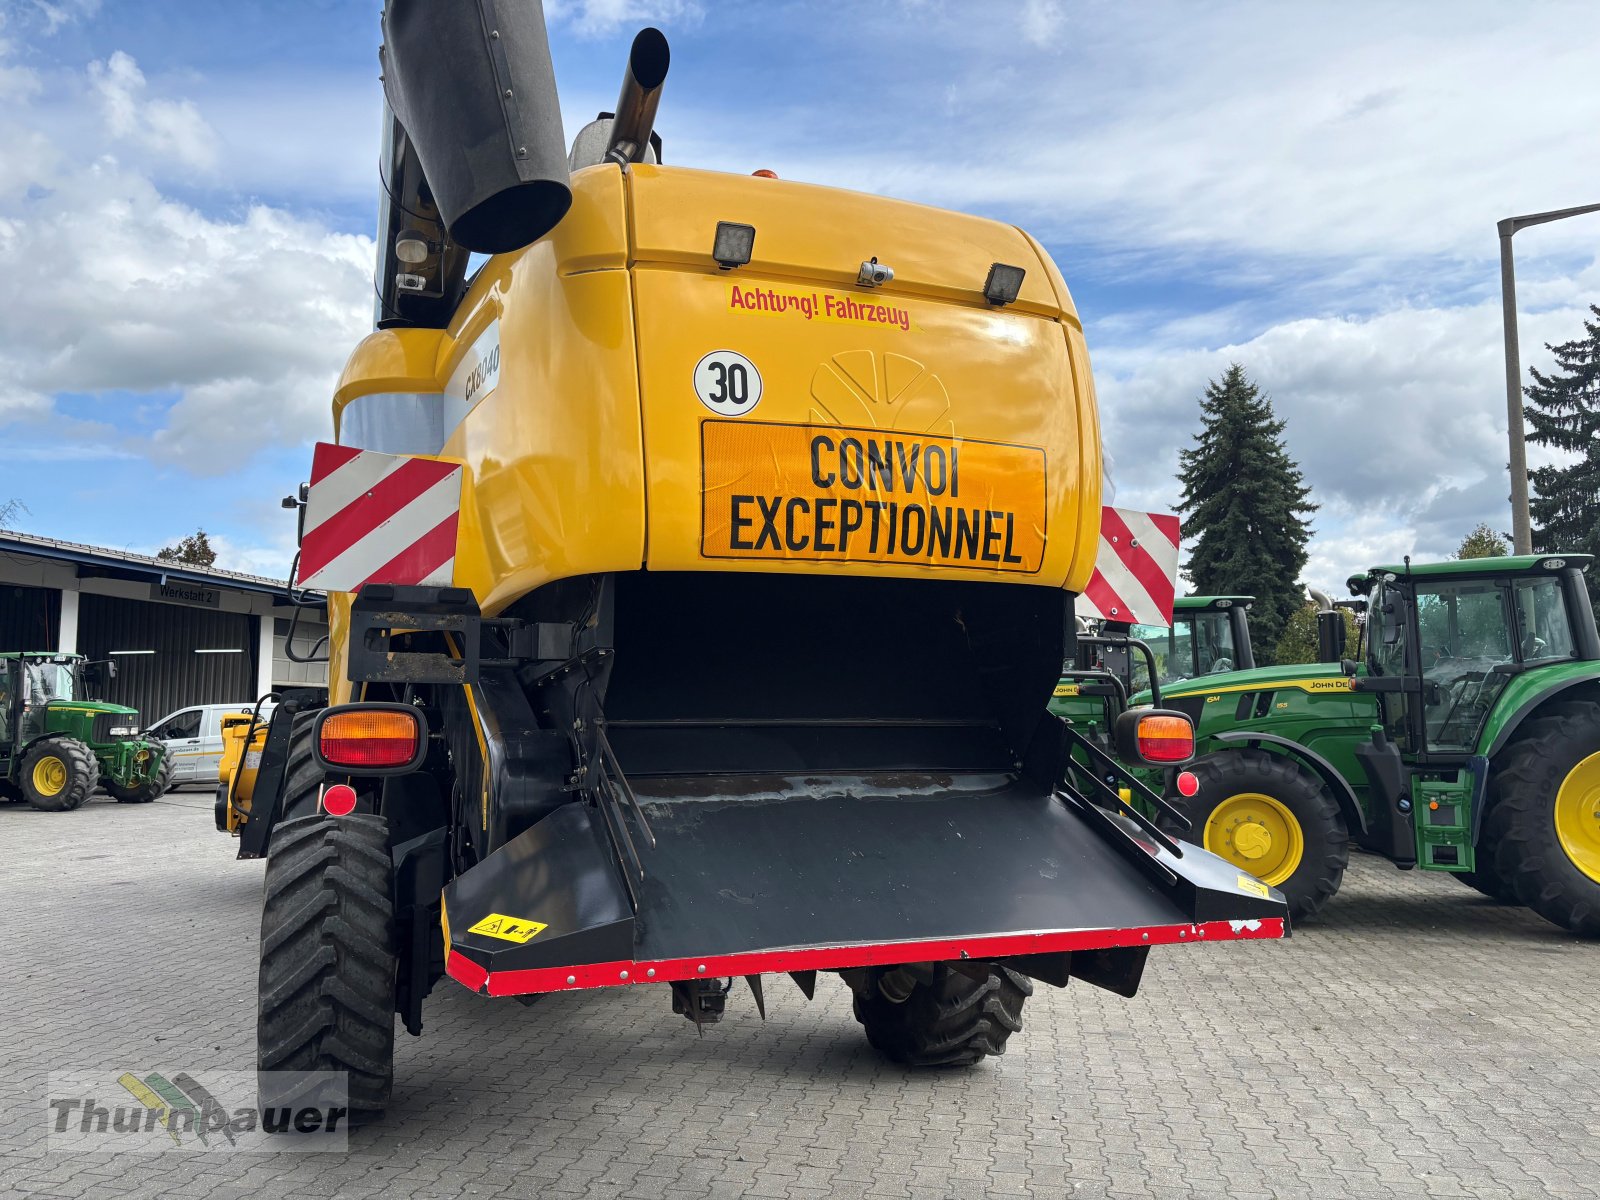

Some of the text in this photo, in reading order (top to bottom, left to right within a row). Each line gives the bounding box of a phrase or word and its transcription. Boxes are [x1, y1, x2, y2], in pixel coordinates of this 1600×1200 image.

[731, 285, 910, 331] Achtung! Fahrzeug
[465, 344, 500, 402] CX8040
[707, 361, 748, 405] 30
[810, 435, 959, 498] CONVOI
[730, 495, 1022, 564] EXCEPTIONNEL
[160, 585, 213, 603] Werkstatt 2
[1207, 695, 1221, 703] 6M
[1311, 681, 1334, 689] JOHN
